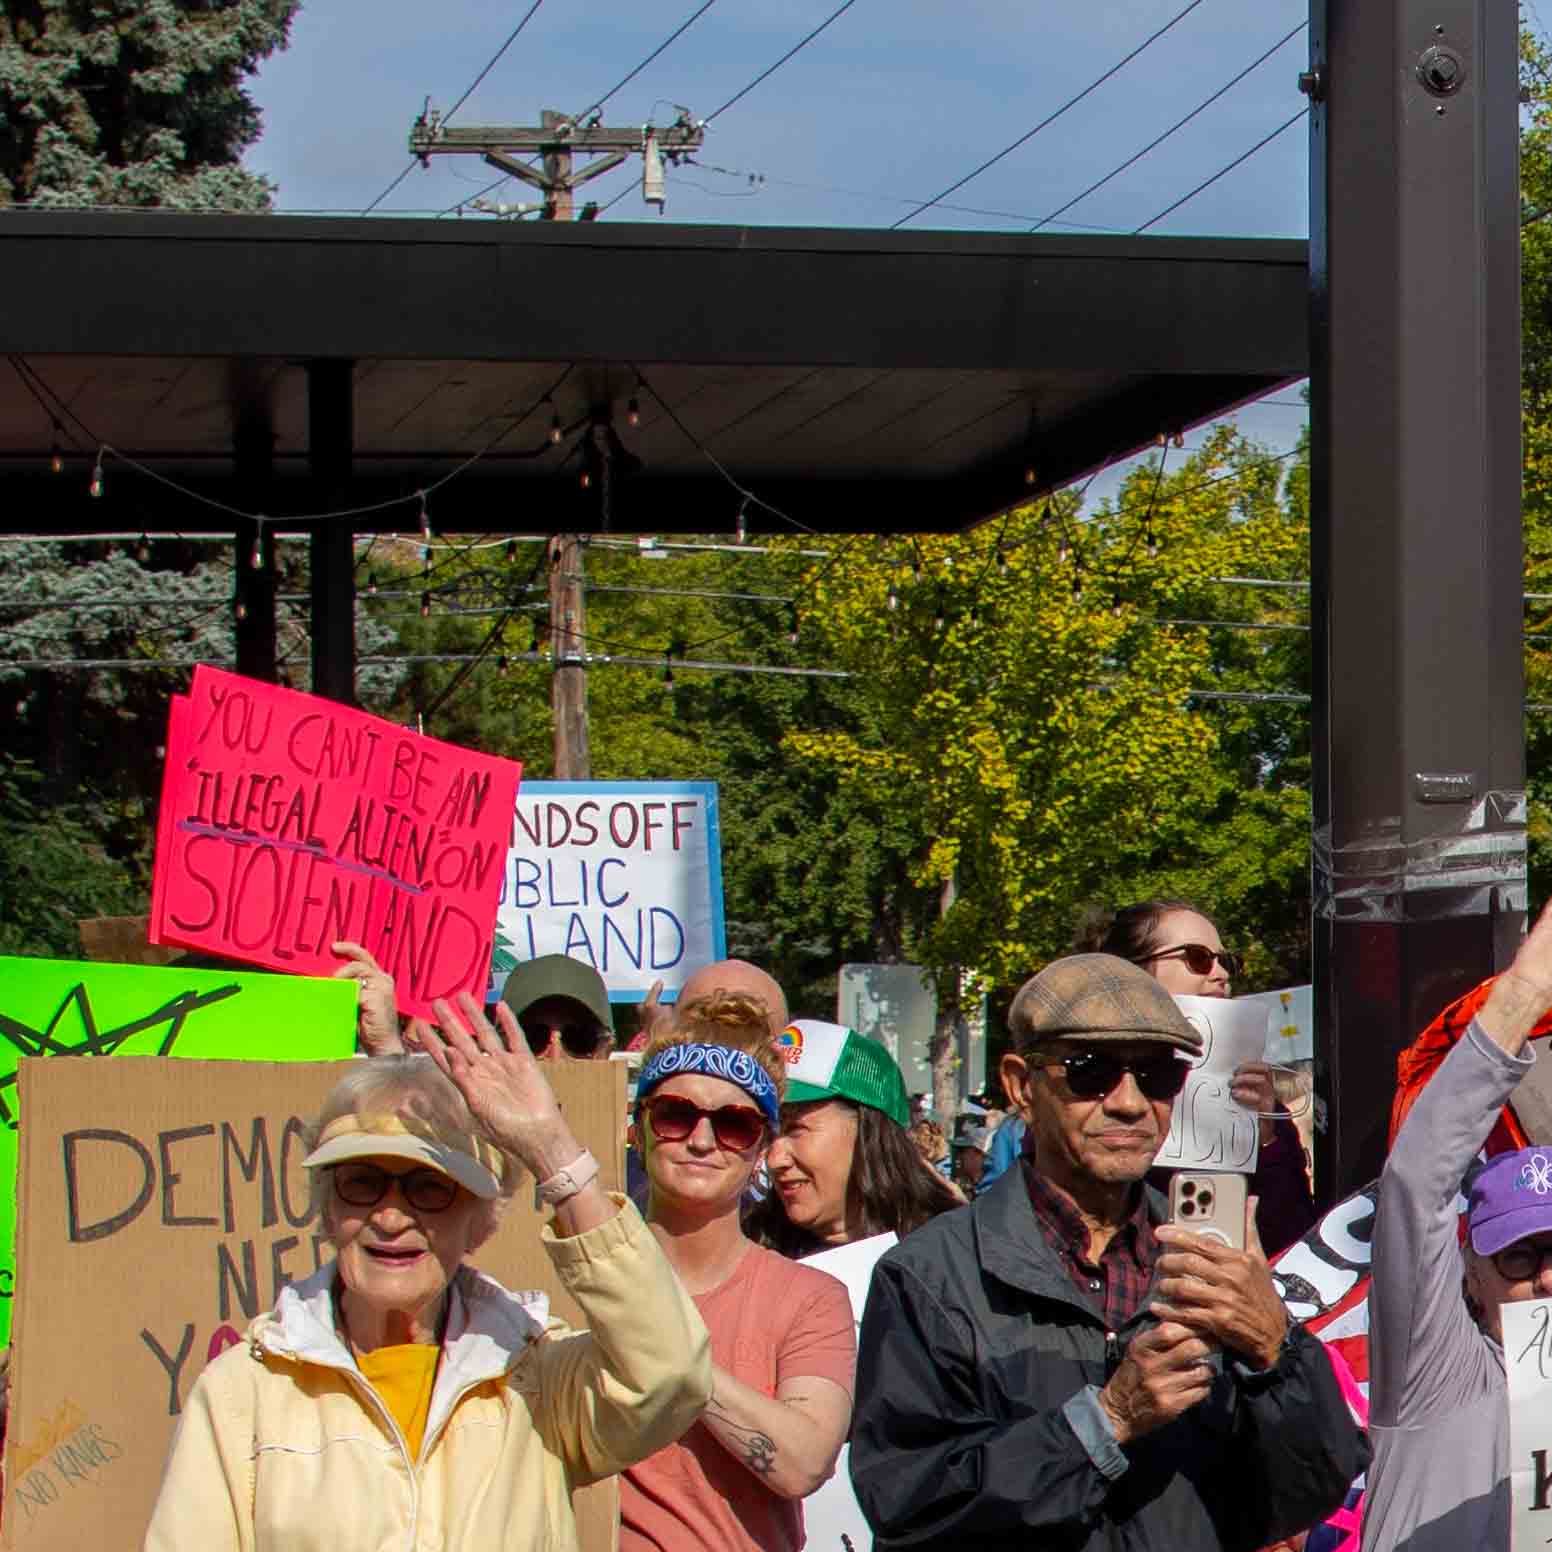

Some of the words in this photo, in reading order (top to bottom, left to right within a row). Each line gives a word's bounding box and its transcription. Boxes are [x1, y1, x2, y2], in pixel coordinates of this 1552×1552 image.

[199, 685, 273, 754] YOU
[287, 713, 383, 784] CAN'T
[390, 739, 439, 817] BE
[435, 767, 491, 830] AN
[434, 841, 497, 892] ON
[608, 799, 698, 850] OFF
[170, 833, 355, 960] STOLEN
